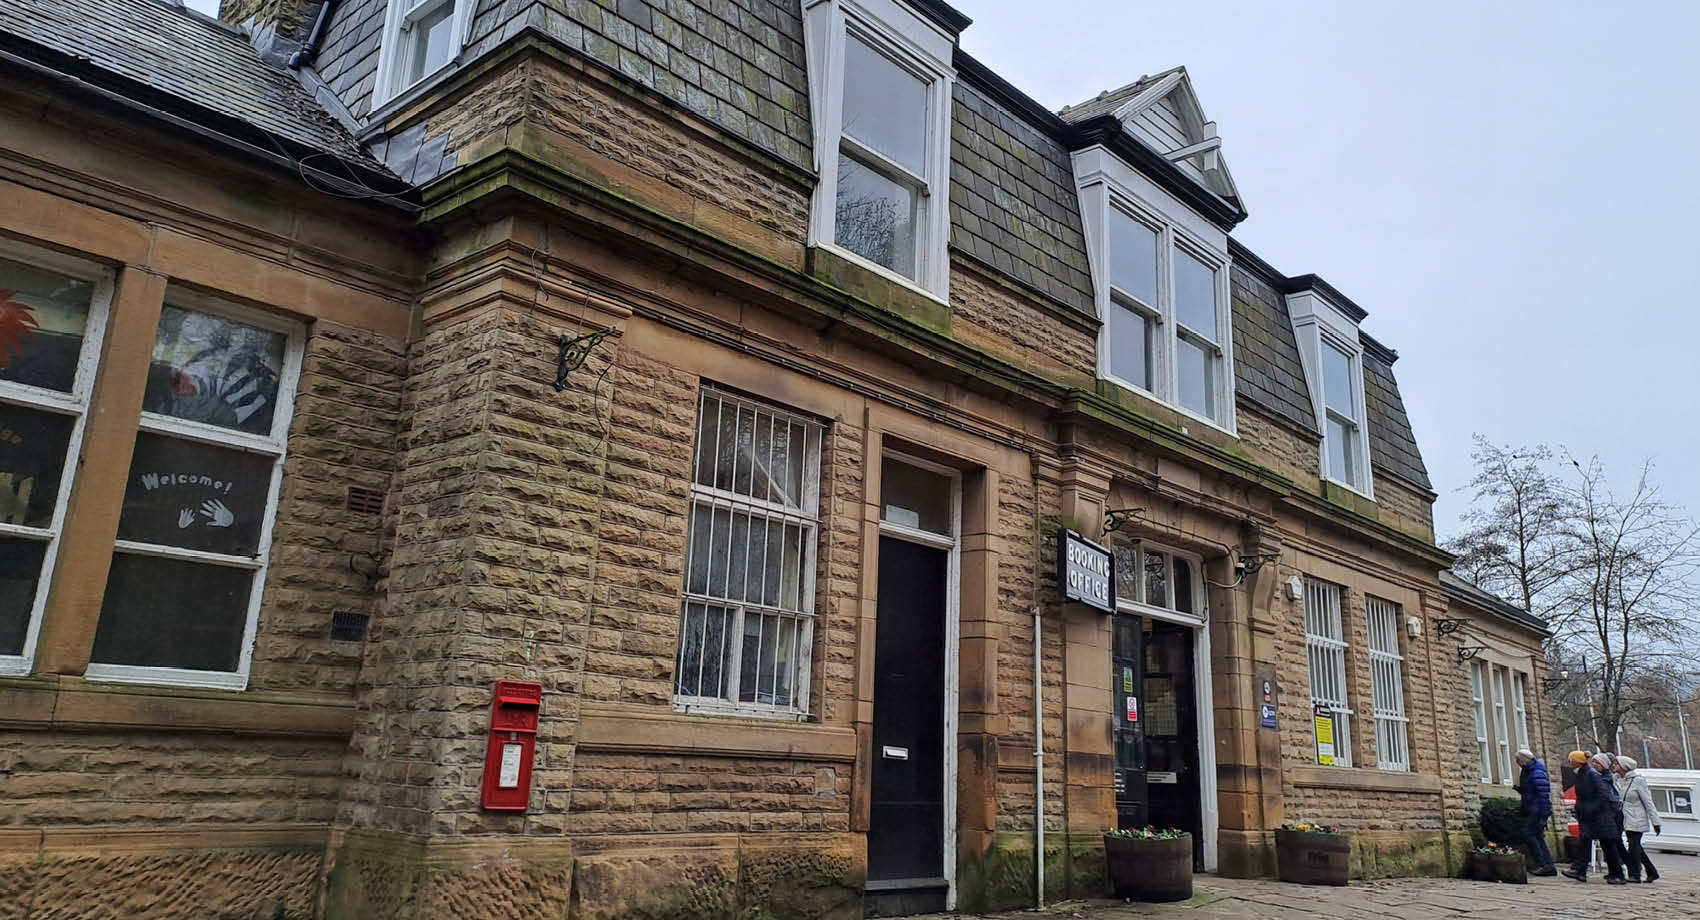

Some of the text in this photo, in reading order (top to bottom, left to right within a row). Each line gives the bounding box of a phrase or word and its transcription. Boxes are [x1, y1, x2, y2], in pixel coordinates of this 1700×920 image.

[141, 473, 233, 495] Welcome!
[1068, 543, 1110, 577] BOOKING
[1070, 570, 1108, 601] OFFICE
